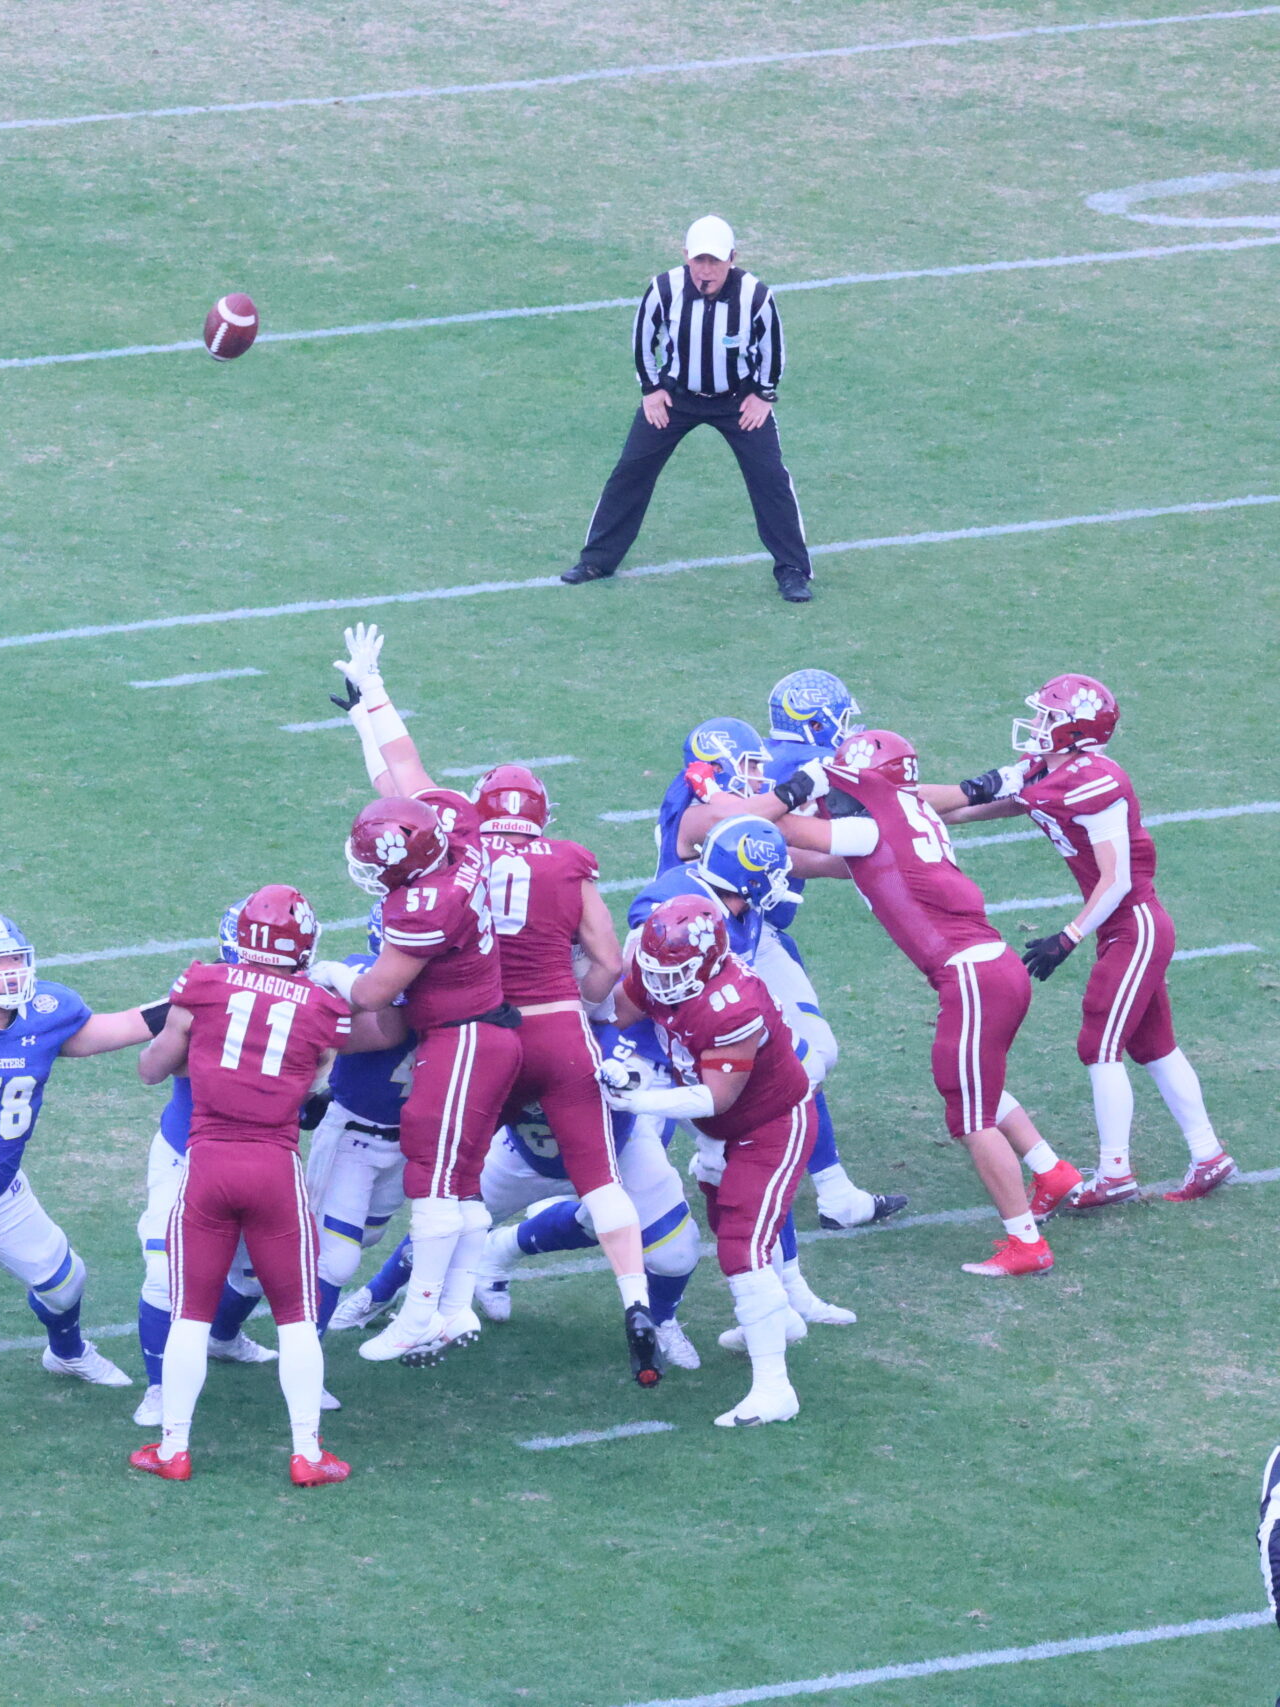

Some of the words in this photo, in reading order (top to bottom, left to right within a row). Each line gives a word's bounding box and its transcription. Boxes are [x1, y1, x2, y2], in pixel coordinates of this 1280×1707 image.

[508, 791, 521, 815] 0
[491, 822, 532, 833] Riddell
[406, 887, 438, 912] 57
[489, 855, 531, 935] 0
[249, 923, 270, 949] 11
[241, 950, 281, 964] Riddell
[225, 966, 311, 1005] YAMAGUCHI
[220, 991, 297, 1077] 11
